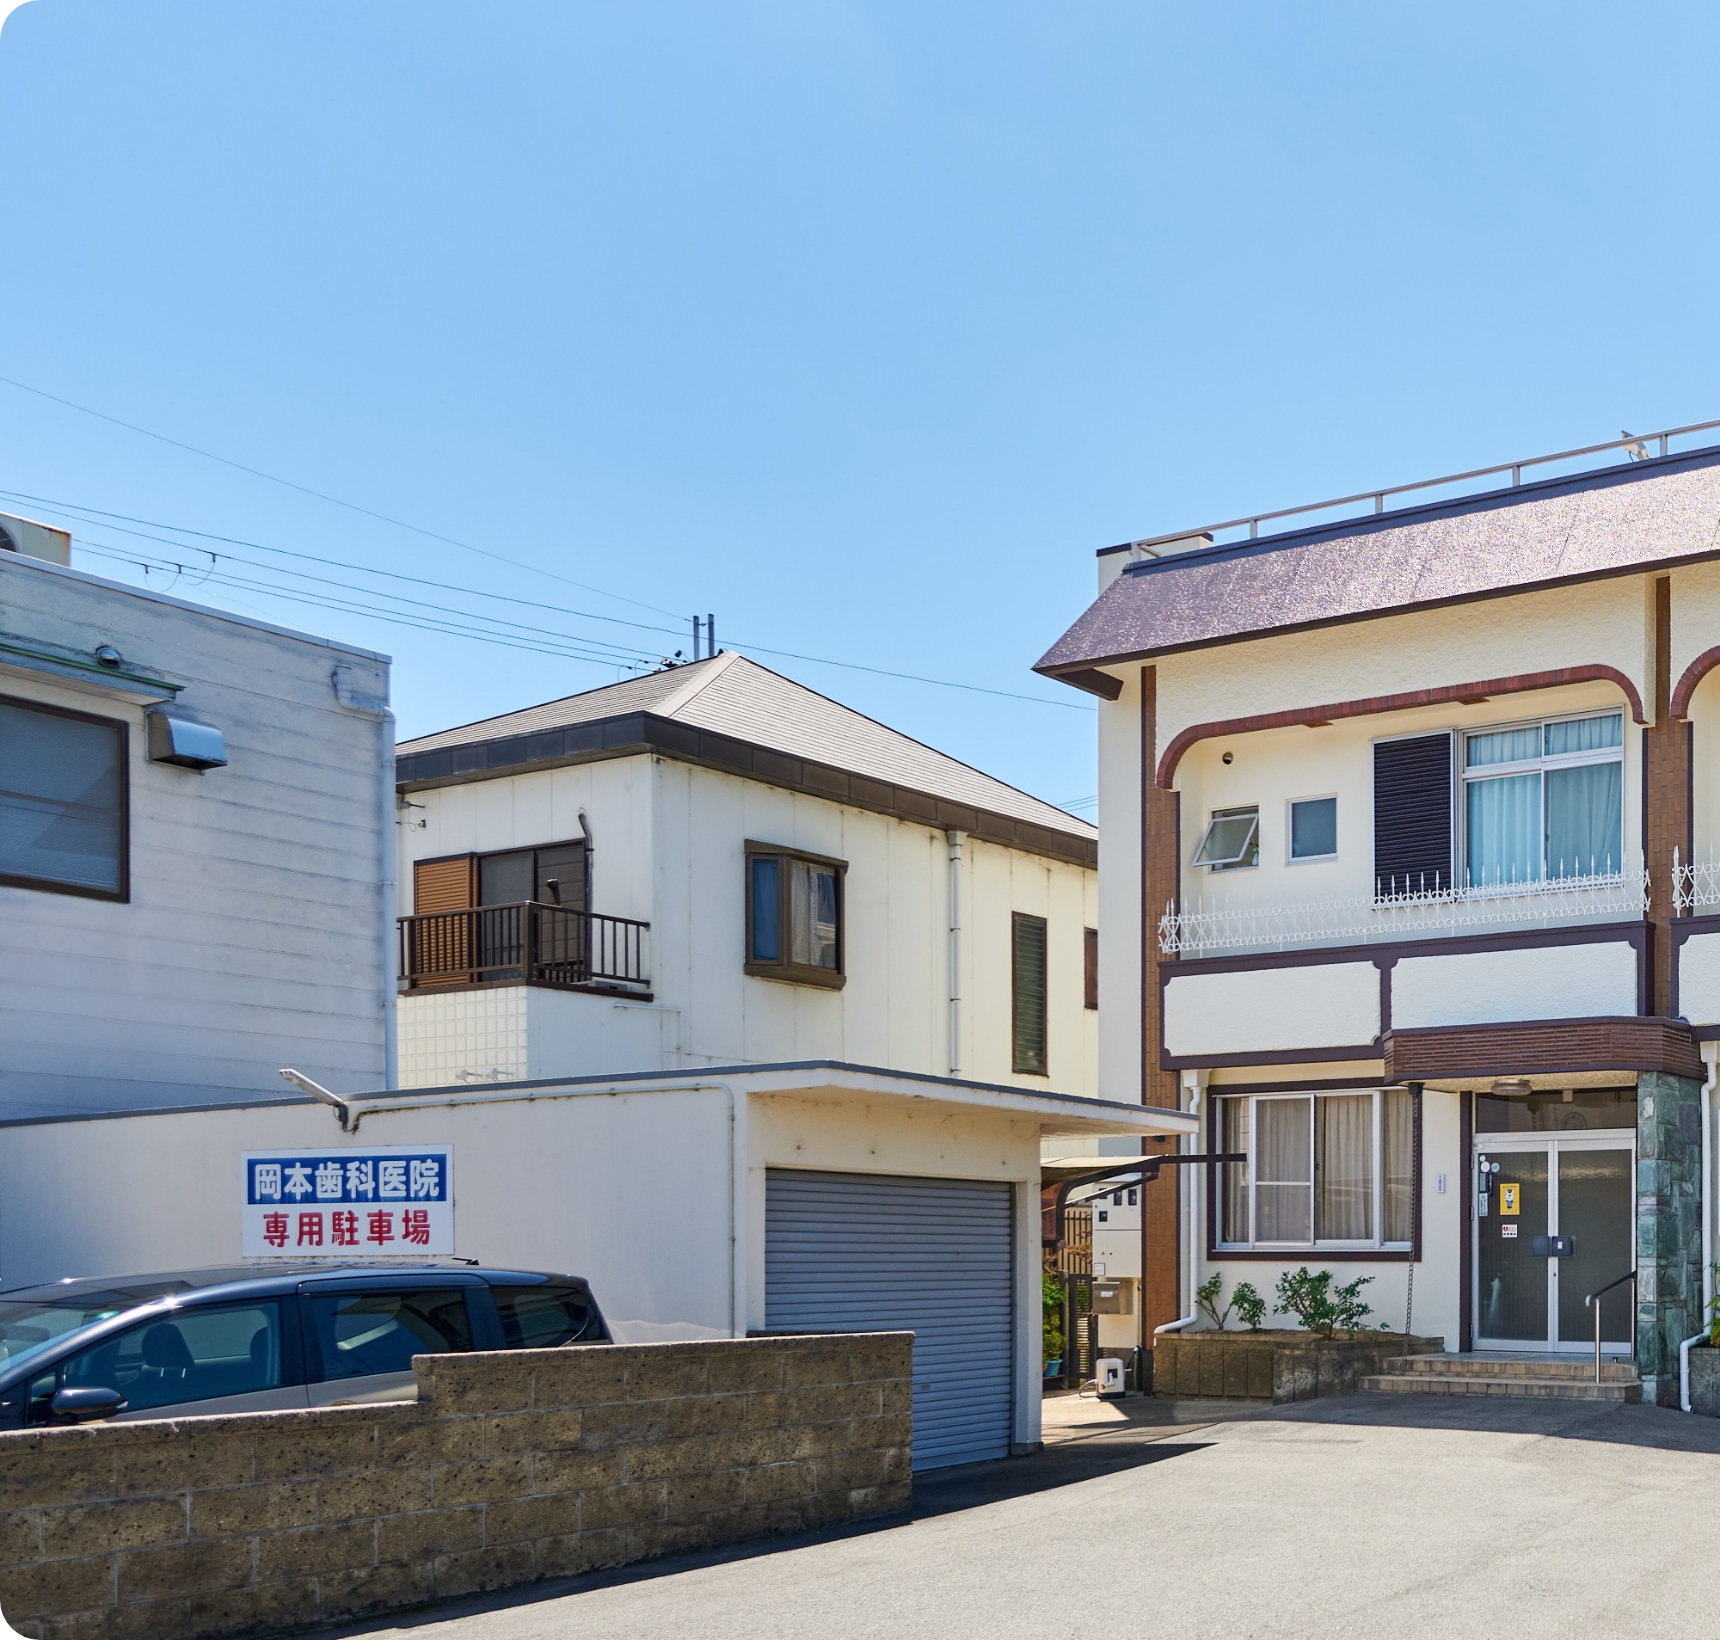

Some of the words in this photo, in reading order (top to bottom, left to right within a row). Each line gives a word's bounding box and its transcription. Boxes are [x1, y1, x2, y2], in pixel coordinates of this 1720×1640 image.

[255, 1159, 440, 1200] 岡本歯科医院
[263, 1208, 431, 1248] 専用駐車場
